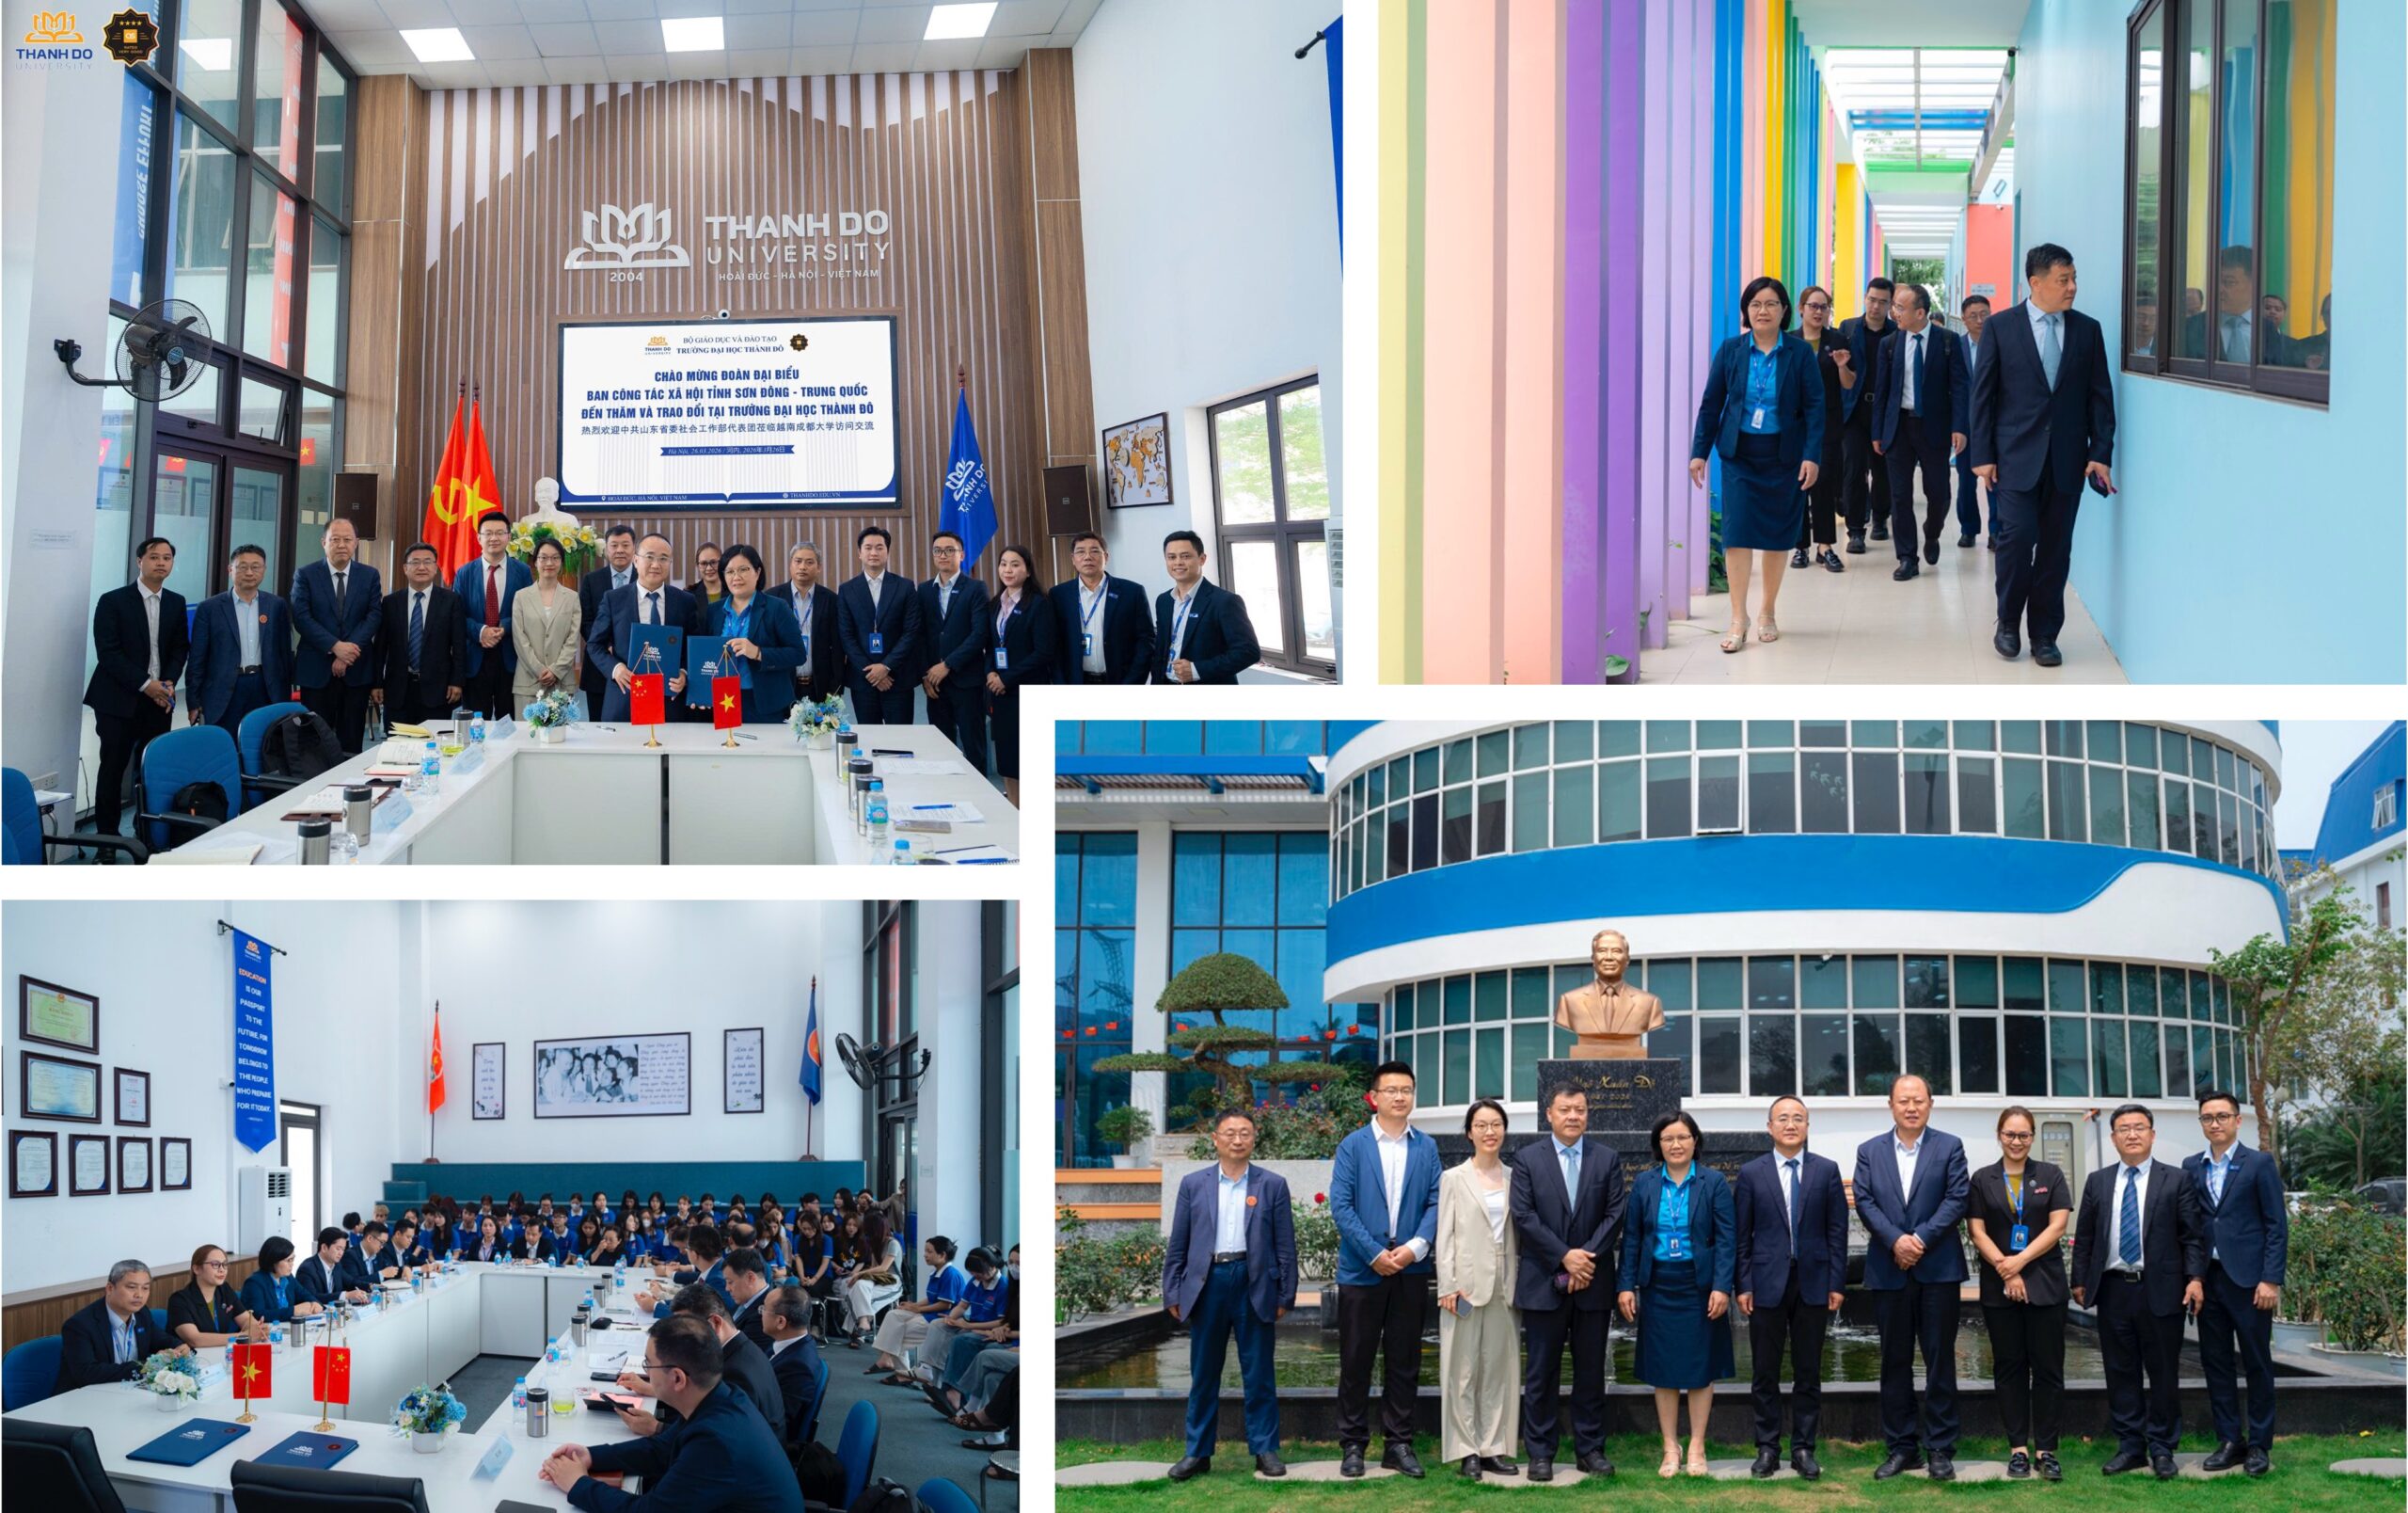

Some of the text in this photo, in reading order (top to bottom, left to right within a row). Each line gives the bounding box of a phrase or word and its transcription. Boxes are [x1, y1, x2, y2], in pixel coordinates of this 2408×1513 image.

[705, 209, 889, 240] THANH DO
[707, 241, 890, 265] UNIVERSITY
[610, 271, 644, 282] 2004
[855, 268, 879, 279] NAM
[655, 365, 800, 382] CHÀO MỪNG ĐOÀN ĐẠI BIỂU
[587, 390, 609, 401] BAN
[612, 388, 642, 401] CÔNG
[644, 387, 665, 400] TÁC
[668, 387, 682, 400] XÃ
[686, 387, 704, 401] HỘI
[707, 385, 731, 399] TỈNH
[736, 387, 757, 399] SƠN
[760, 385, 789, 398] ĐÔNG
[800, 386, 836, 397] TRUNG
[839, 382, 868, 398] QUỐC
[581, 401, 874, 420] ĐẾN THĂM VÀ TRAO ĐỔI TẠI TRƯỜNG ĐẠI HỌC THÀNH ĐÔ
